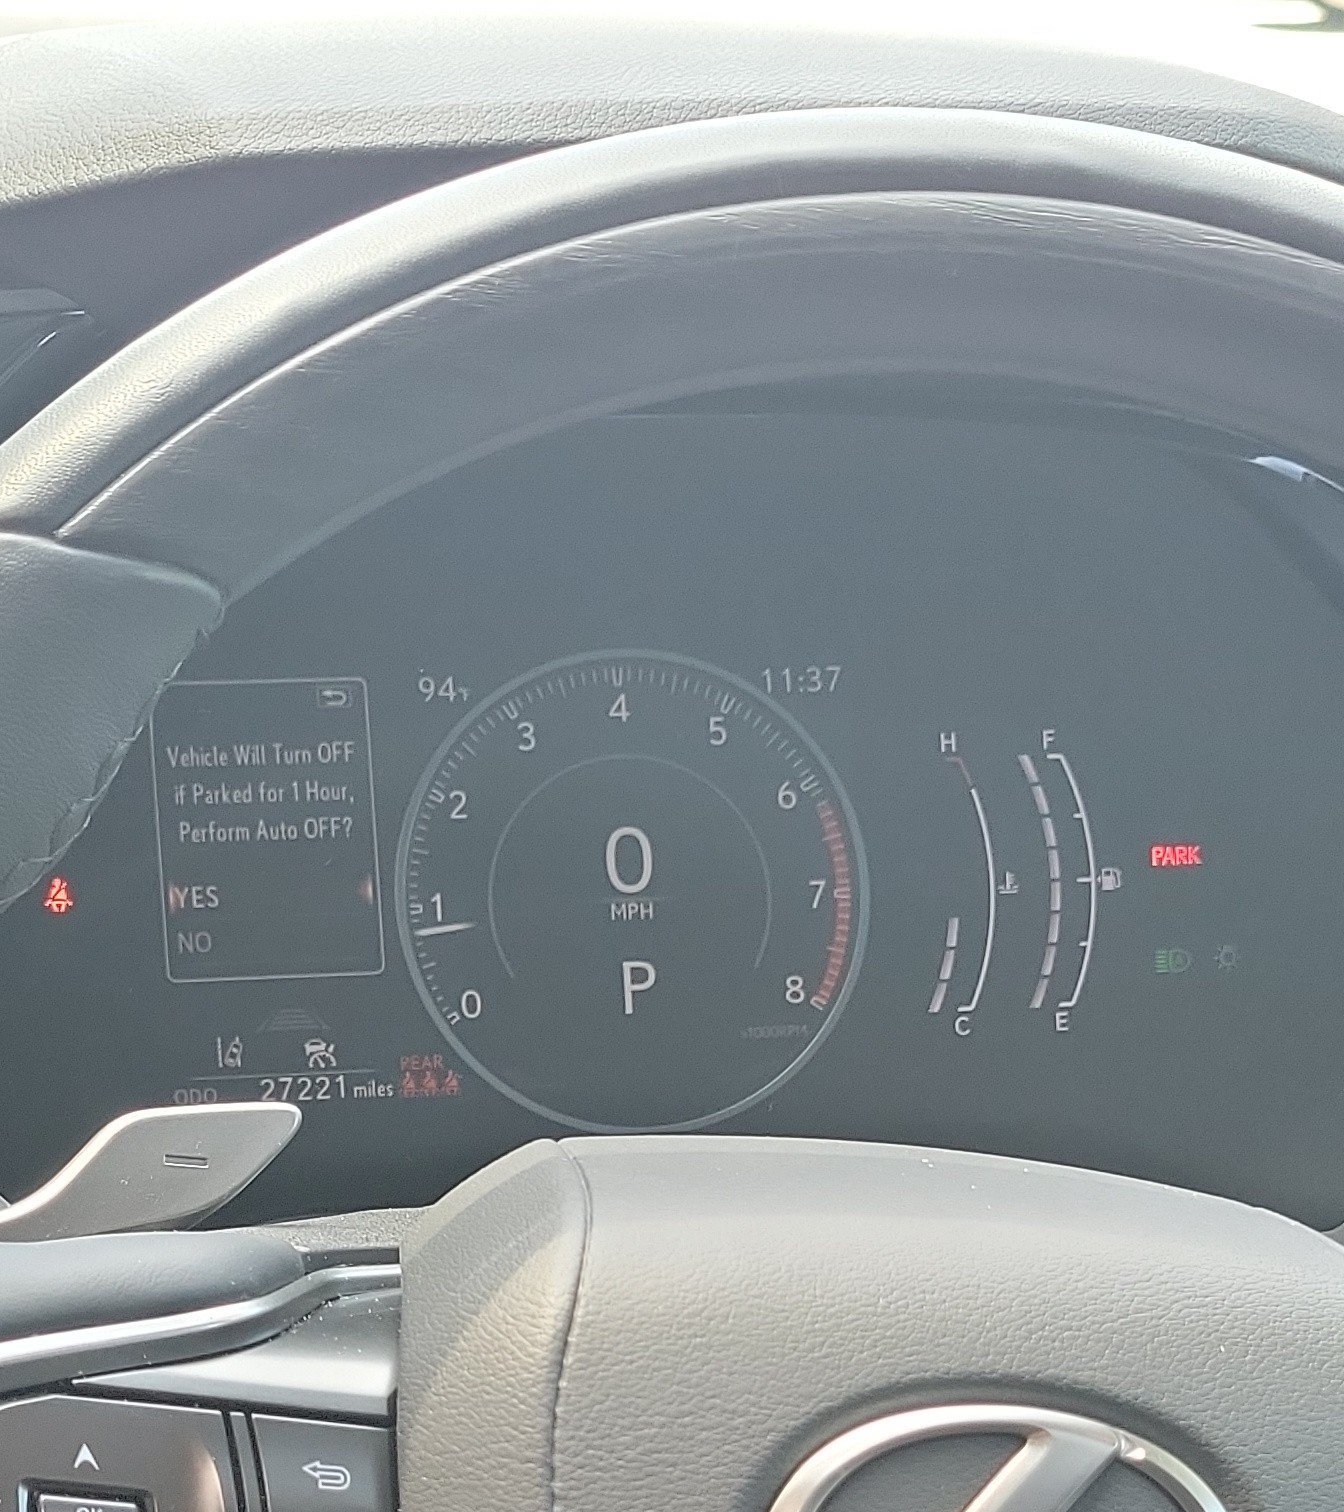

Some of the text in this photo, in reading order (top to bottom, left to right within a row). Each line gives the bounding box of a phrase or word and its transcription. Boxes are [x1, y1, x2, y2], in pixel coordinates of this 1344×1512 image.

[761, 665, 842, 693] 11:37
[609, 693, 632, 723] 4
[516, 722, 537, 751] 3
[708, 716, 728, 746] 5
[939, 731, 957, 753] H
[1042, 729, 1056, 750] F
[166, 741, 355, 768] Vehicle Will Turn OFF
[174, 780, 354, 805] if Parked for 1 Hour,
[449, 790, 469, 819] 2
[777, 781, 797, 810] 6
[179, 817, 353, 843] Perform Auto OFF?
[605, 827, 653, 894] 0
[1151, 845, 1202, 866] PARK
[173, 886, 219, 909] YES
[430, 892, 443, 922] 1
[808, 879, 826, 909] 7
[611, 902, 654, 921] MPH
[177, 931, 212, 953] NO
[622, 961, 656, 1015] P
[786, 975, 805, 1004] 8
[461, 989, 481, 1018] 0
[954, 1016, 971, 1036] C
[1056, 1012, 1069, 1032] E
[400, 1054, 443, 1070] REAR
[259, 1075, 346, 1101] 27221
[353, 1080, 394, 1098] miles
